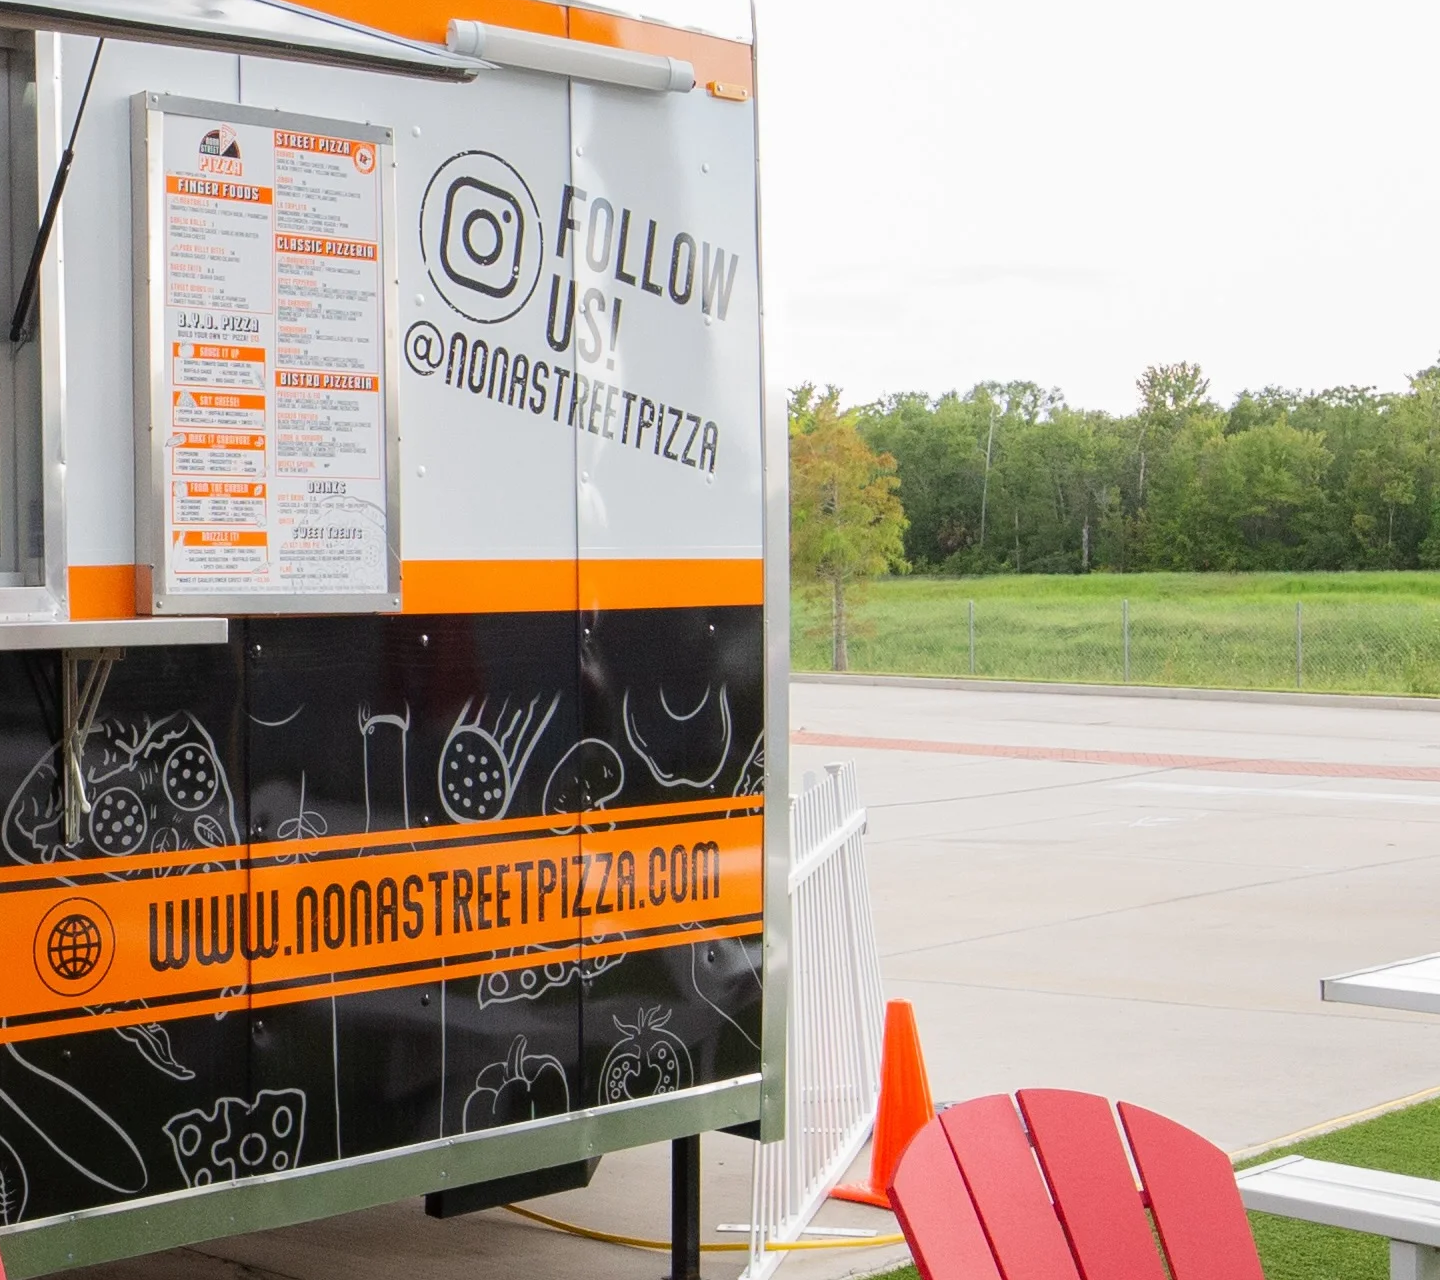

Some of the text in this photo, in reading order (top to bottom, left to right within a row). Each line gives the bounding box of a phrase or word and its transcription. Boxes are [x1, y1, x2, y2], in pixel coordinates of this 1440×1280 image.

[201, 144, 219, 154] STREET
[276, 132, 351, 154] STREET PIZZA
[199, 156, 242, 176] PIZZA
[178, 179, 219, 196] FINGER
[223, 184, 259, 200] FOODS
[277, 237, 374, 258] CLASSIC PIZZERIA
[555, 183, 739, 322] FOLLOW
[221, 314, 259, 333] PIZZA
[545, 273, 623, 371] US!
[194, 331, 207, 339] YOUR
[221, 347, 229, 358] IT
[231, 348, 240, 358] UP
[281, 372, 373, 390] BISTRO PIZZERIA
[404, 320, 719, 473] @NONASTREETPIZZA
[308, 481, 346, 494] DRINKS
[293, 528, 362, 539] SWEET TREATS
[147, 839, 722, 974] WWW.NONASTREETPIZZA.COM
